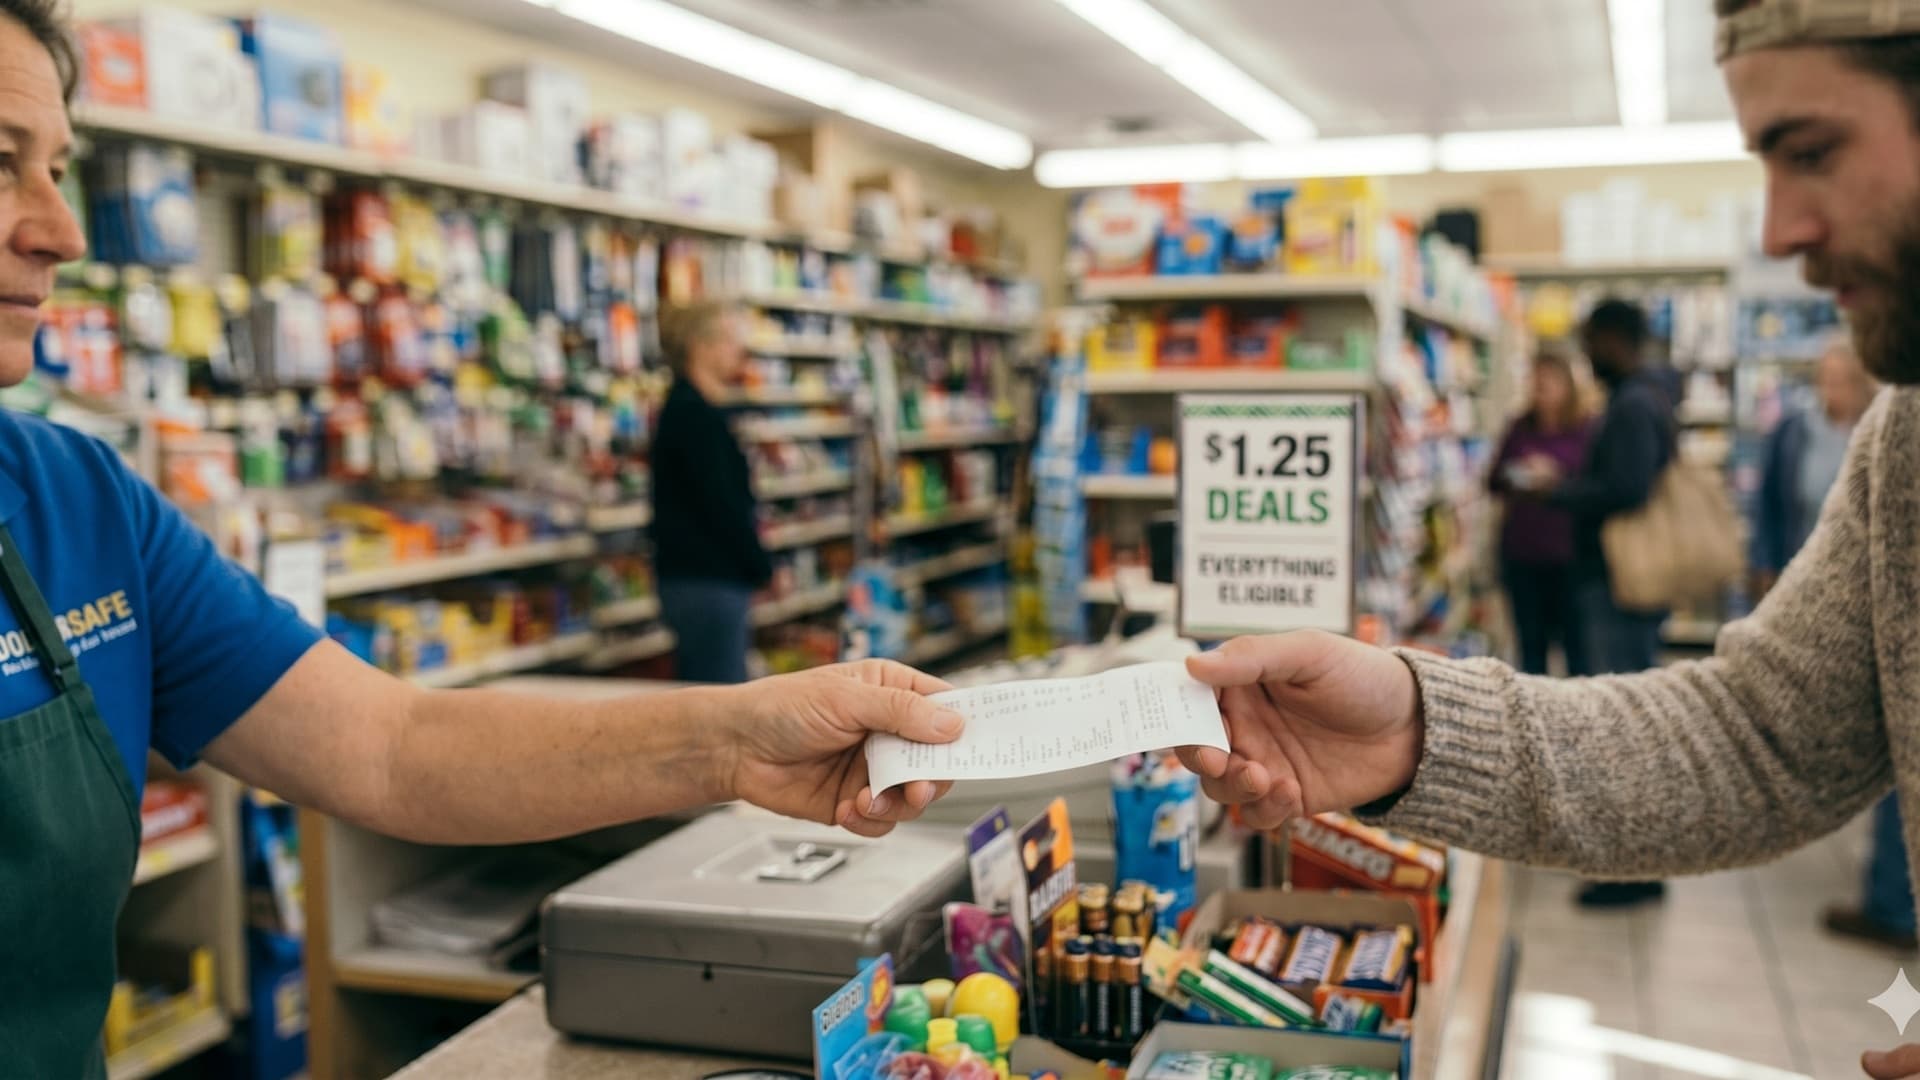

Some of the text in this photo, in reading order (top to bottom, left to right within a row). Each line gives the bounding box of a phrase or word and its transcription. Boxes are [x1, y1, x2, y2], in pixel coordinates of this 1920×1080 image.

[1205, 433, 1331, 478] $1.25
[1207, 489, 1329, 523] DEALS
[1198, 553, 1336, 577] EVERYTHING
[1219, 583, 1315, 606] ELIGIBLE
